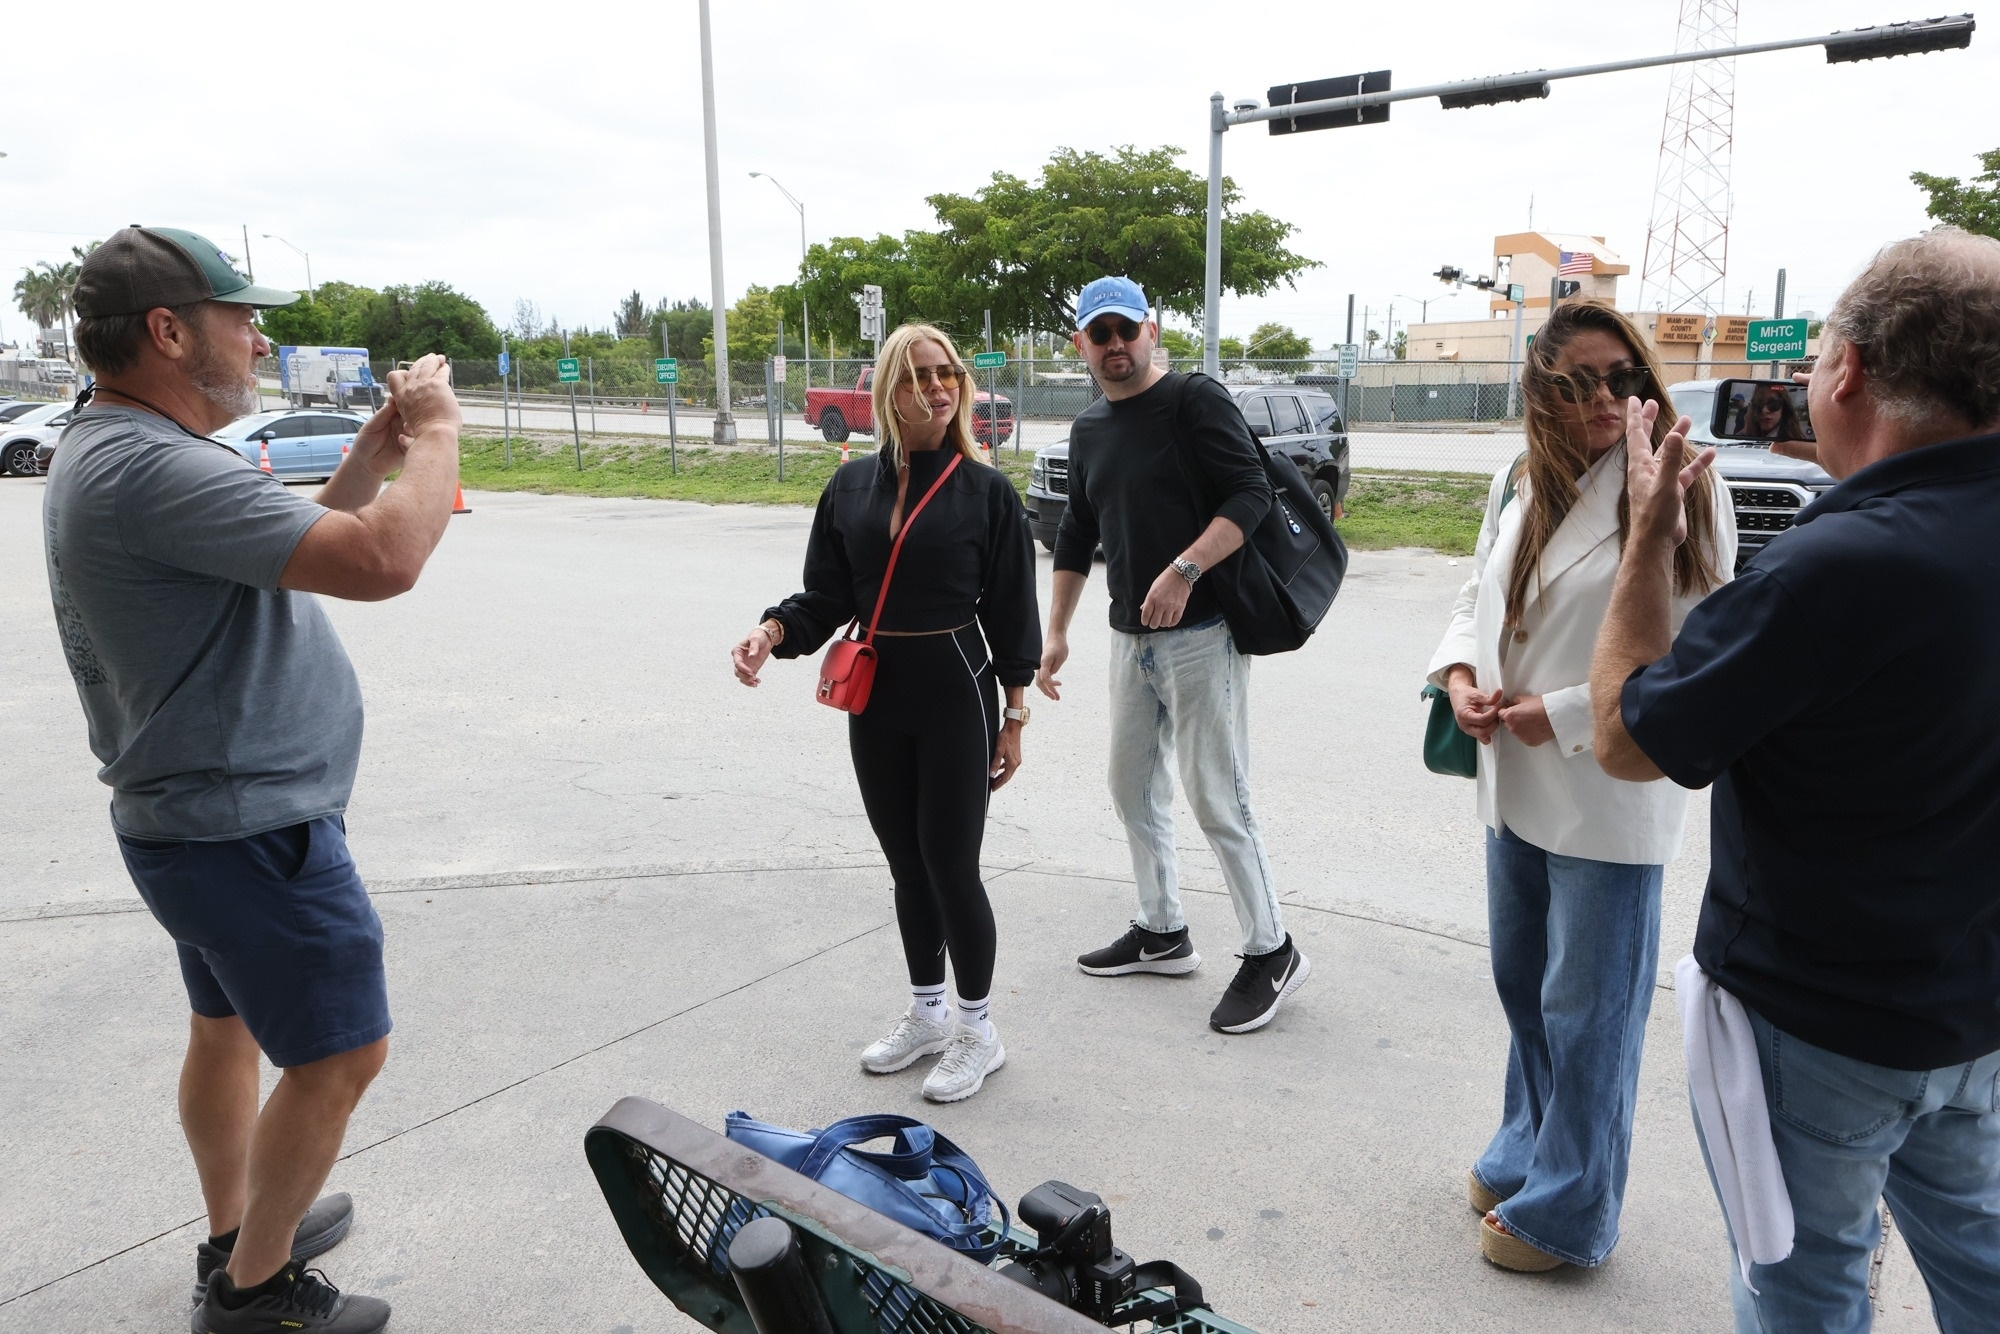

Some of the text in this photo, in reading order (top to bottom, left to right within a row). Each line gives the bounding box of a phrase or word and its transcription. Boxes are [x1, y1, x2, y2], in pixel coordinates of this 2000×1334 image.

[1666, 317, 1698, 325] MIAMI-DADE
[1663, 332, 1675, 340] FIRE
[1760, 325, 1794, 338] MHTC
[1750, 340, 1803, 354] Sergeant
[561, 362, 575, 370] Facility
[976, 357, 996, 366] Forensic
[926, 998, 942, 1007] alo
[979, 1010, 989, 1020] al
[1094, 1280, 1102, 1304] Nikon
